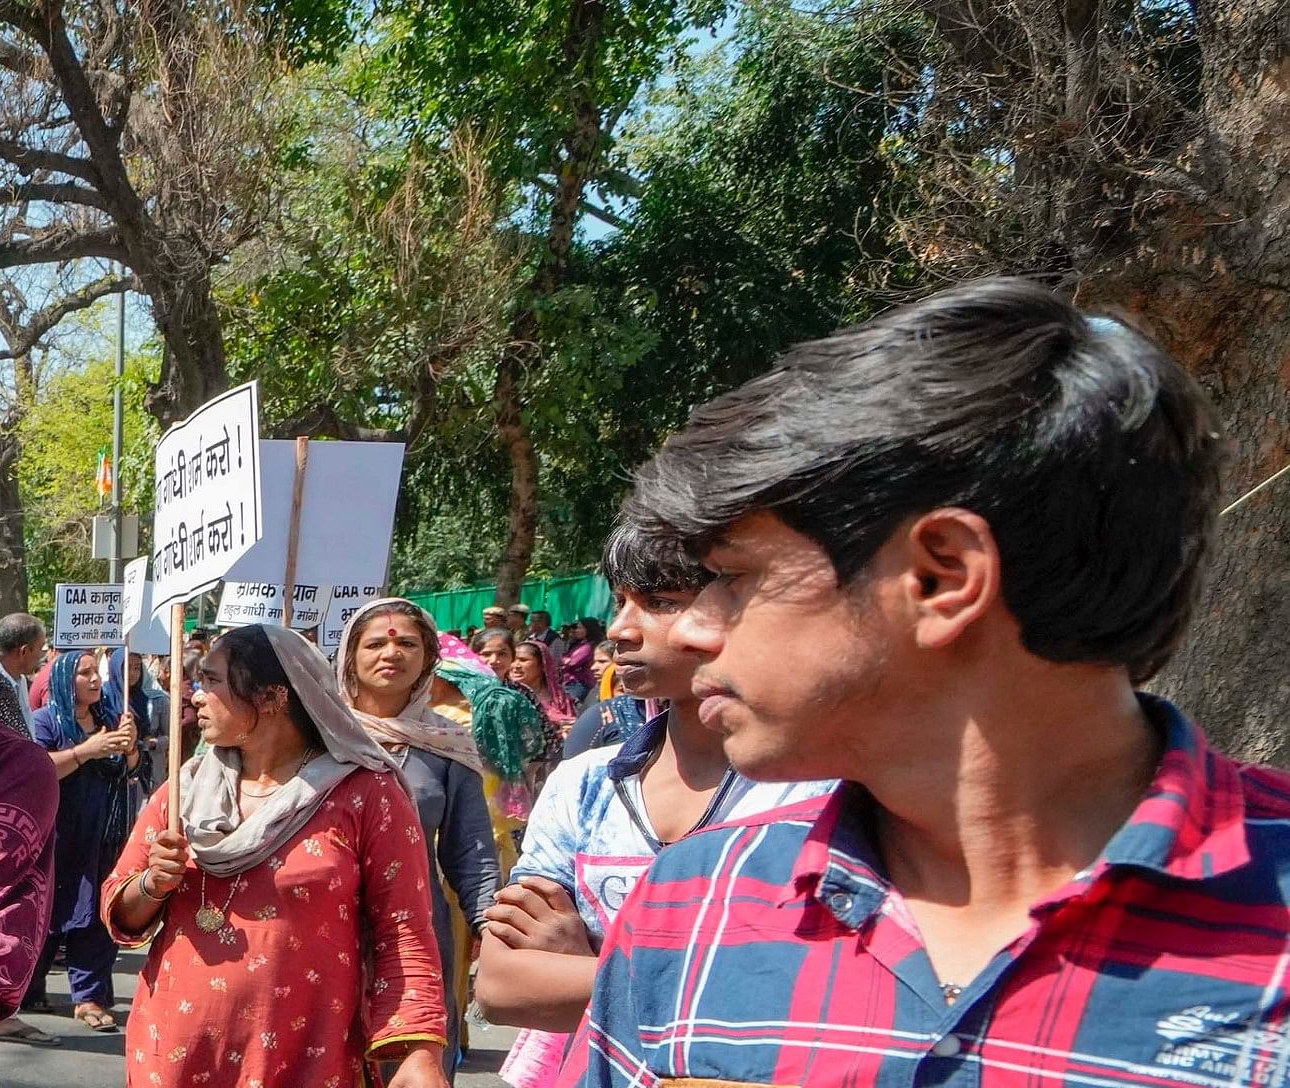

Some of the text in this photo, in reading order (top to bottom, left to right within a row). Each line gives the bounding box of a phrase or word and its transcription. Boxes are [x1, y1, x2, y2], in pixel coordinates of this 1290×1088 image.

[163, 448, 187, 506] गांधी
[206, 424, 231, 481] करो
[236, 424, 242, 469] !
[163, 521, 188, 577] गांधी
[207, 500, 233, 558] करो
[239, 501, 245, 546] !
[65, 588, 87, 605] CAA
[90, 591, 122, 611] कानून
[71, 612, 105, 628] भ्रामक
[243, 603, 265, 617] गांधी
[297, 608, 319, 622] मांगो
[59, 631, 80, 644] राहुल
[81, 629, 99, 640] गांधी
